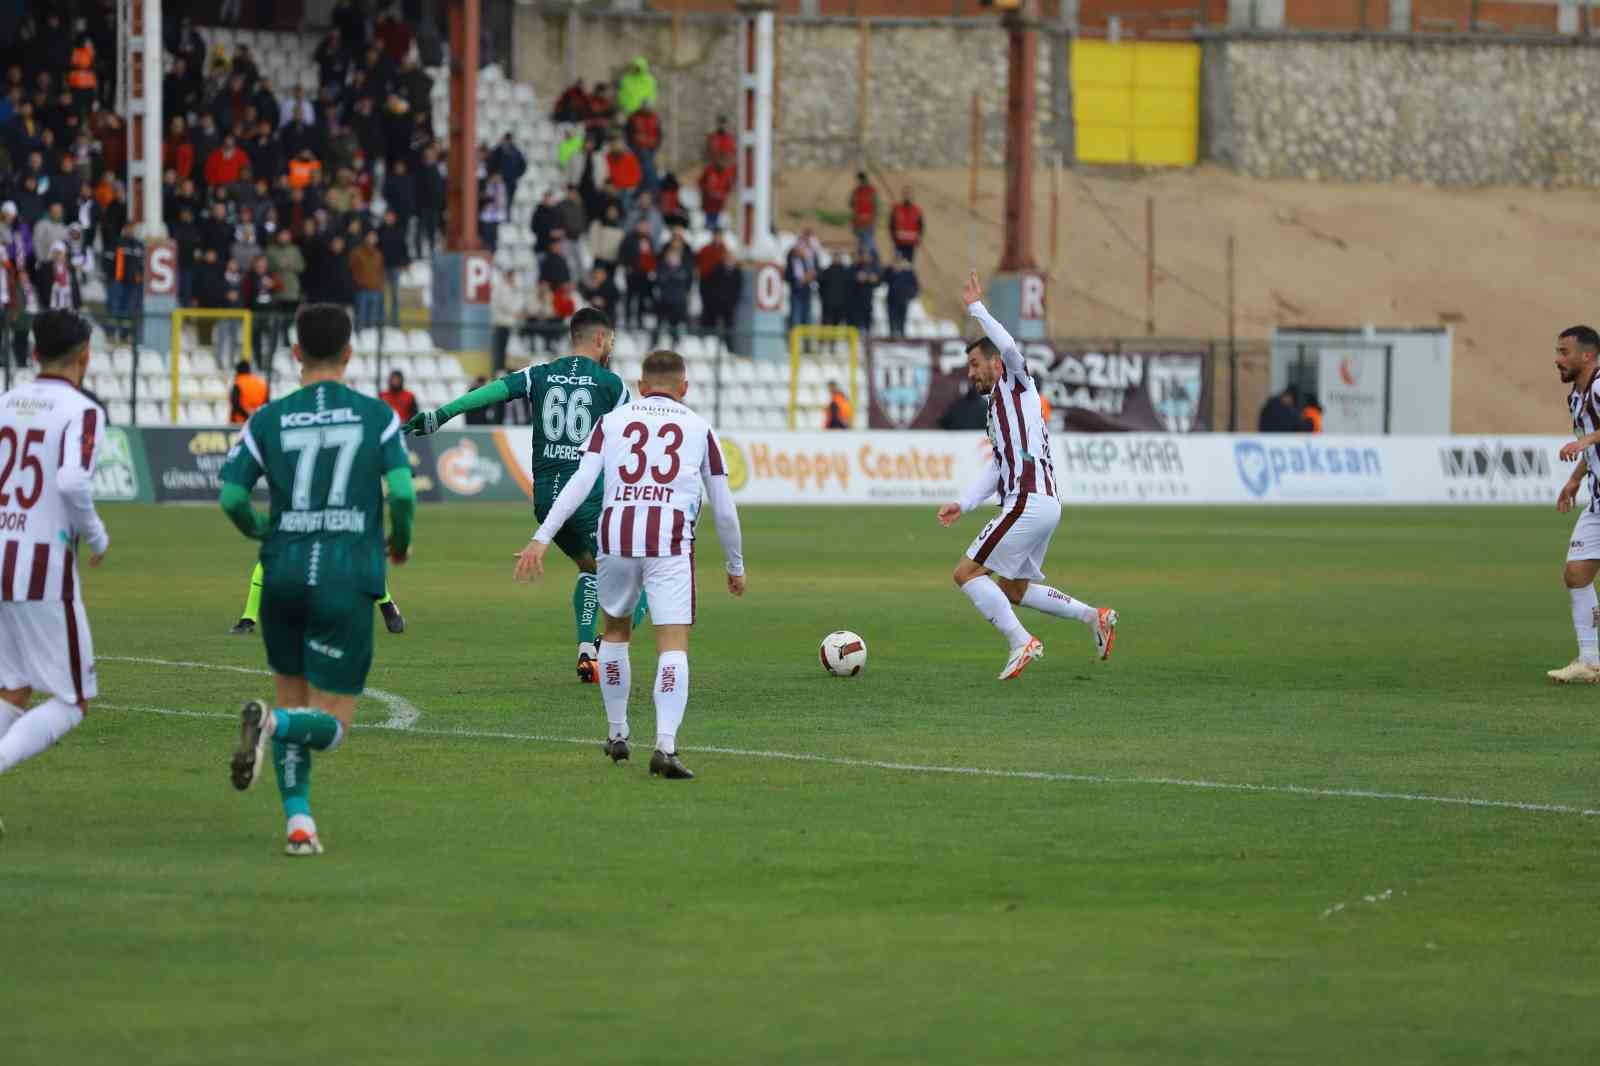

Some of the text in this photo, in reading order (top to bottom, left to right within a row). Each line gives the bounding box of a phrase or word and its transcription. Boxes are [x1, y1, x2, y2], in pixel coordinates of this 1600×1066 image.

[150, 247, 174, 292] S
[466, 257, 488, 300] P
[1023, 275, 1045, 317] R
[280, 406, 362, 428] KOCEL
[542, 385, 592, 444] 66
[0, 426, 46, 510] 25
[280, 423, 363, 510] 77
[618, 421, 683, 485] 33
[750, 441, 955, 491] Happy Center
[1270, 440, 1382, 486] paksan
[614, 486, 674, 503] LEVENT
